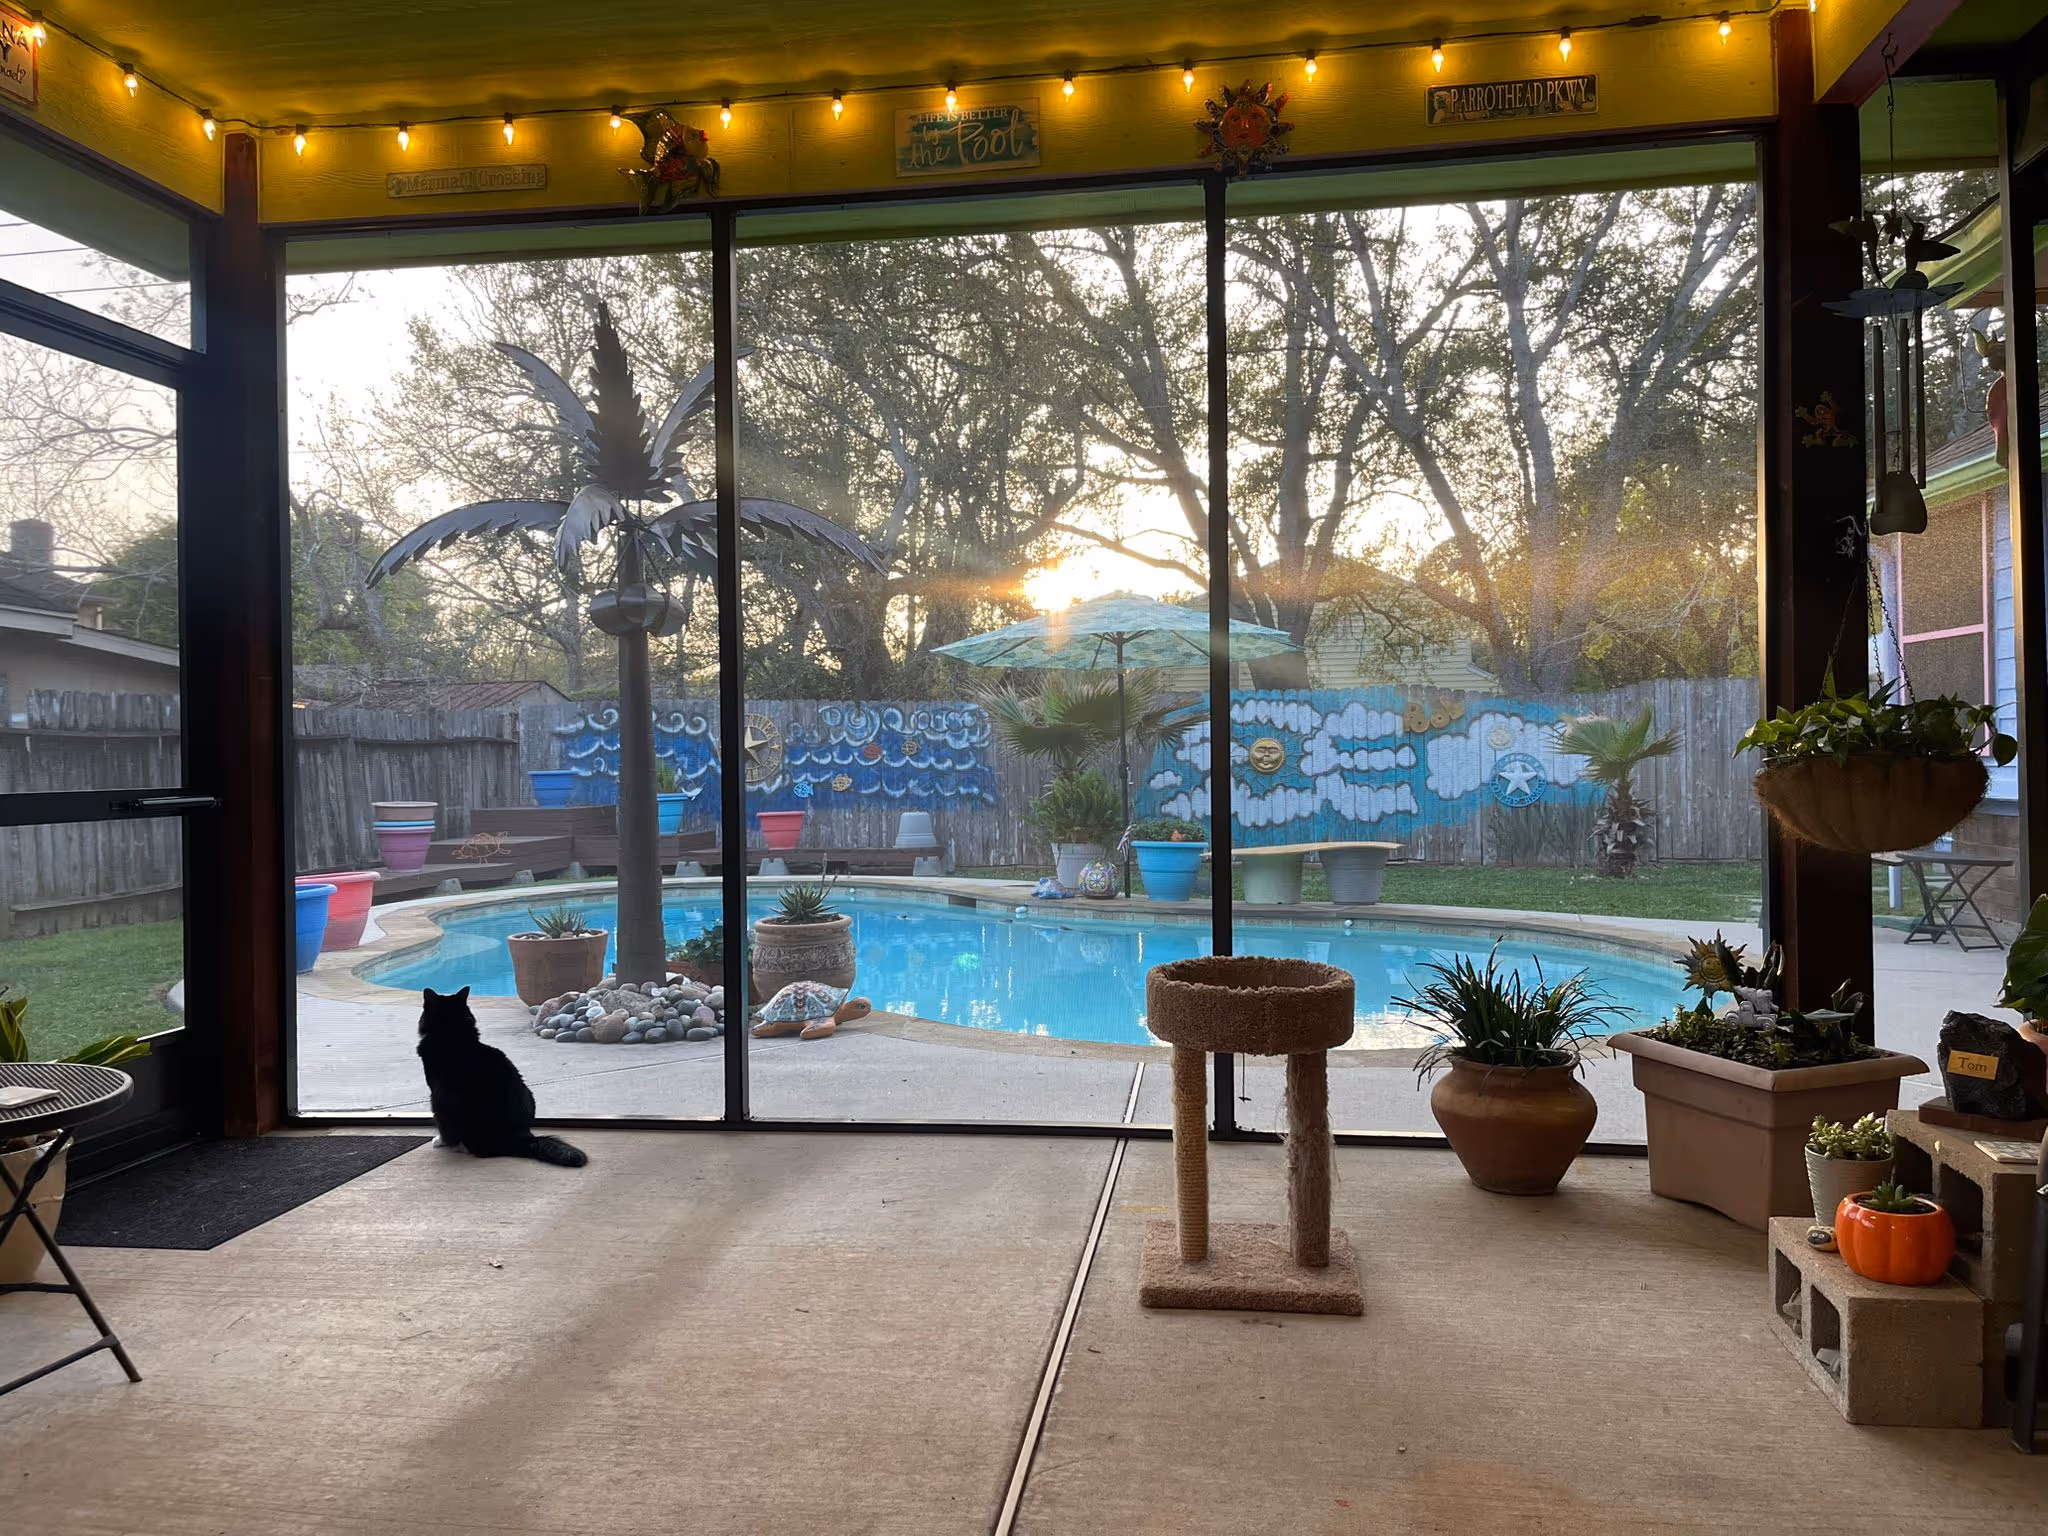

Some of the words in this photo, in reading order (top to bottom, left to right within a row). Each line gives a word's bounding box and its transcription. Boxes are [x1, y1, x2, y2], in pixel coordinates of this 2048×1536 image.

[1451, 82, 1544, 113] PARROTHEAD
[1547, 78, 1589, 103] PKWY
[918, 111, 943, 124] LIFE
[947, 111, 958, 122] IS
[961, 107, 1009, 120] BETTER
[906, 142, 950, 169] the
[949, 108, 1024, 164] Pool
[1958, 1056, 1987, 1073] Tom
